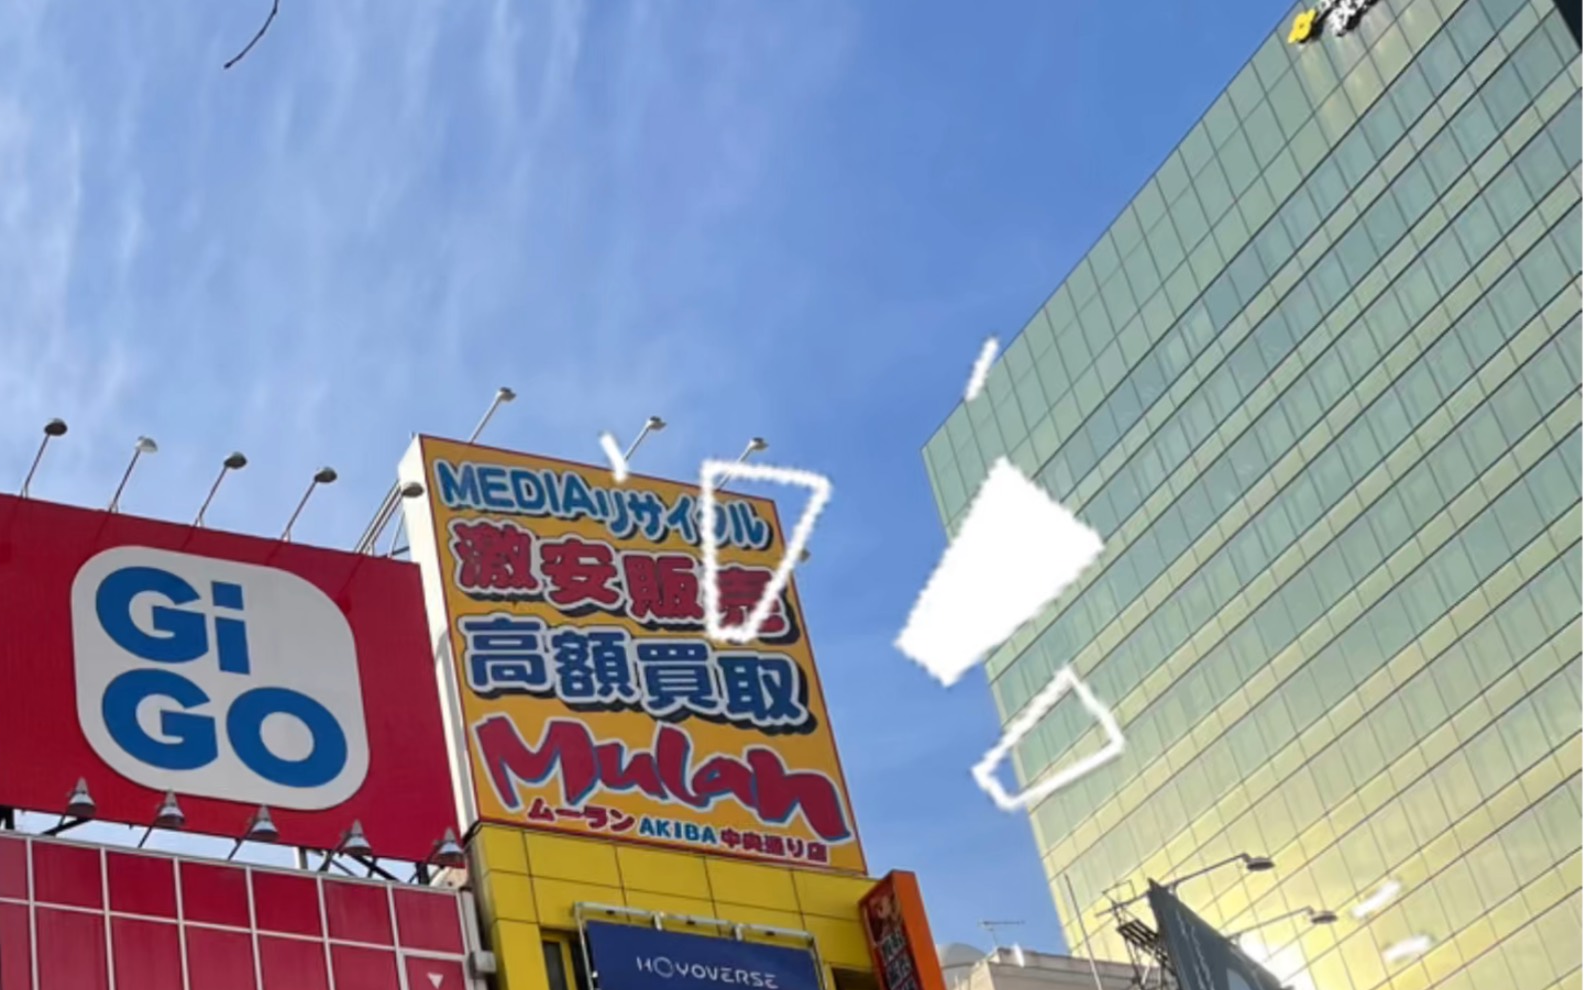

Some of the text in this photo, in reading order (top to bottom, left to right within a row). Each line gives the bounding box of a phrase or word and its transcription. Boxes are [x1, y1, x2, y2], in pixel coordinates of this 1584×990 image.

[453, 521, 787, 637] 激安販売
[462, 618, 807, 724] 高額買取
[103, 668, 347, 788] GO
[475, 716, 850, 842] Mulan
[528, 798, 635, 832] ムーラン
[638, 818, 716, 844] AKIBA
[636, 956, 778, 990] HOYOVERSE
